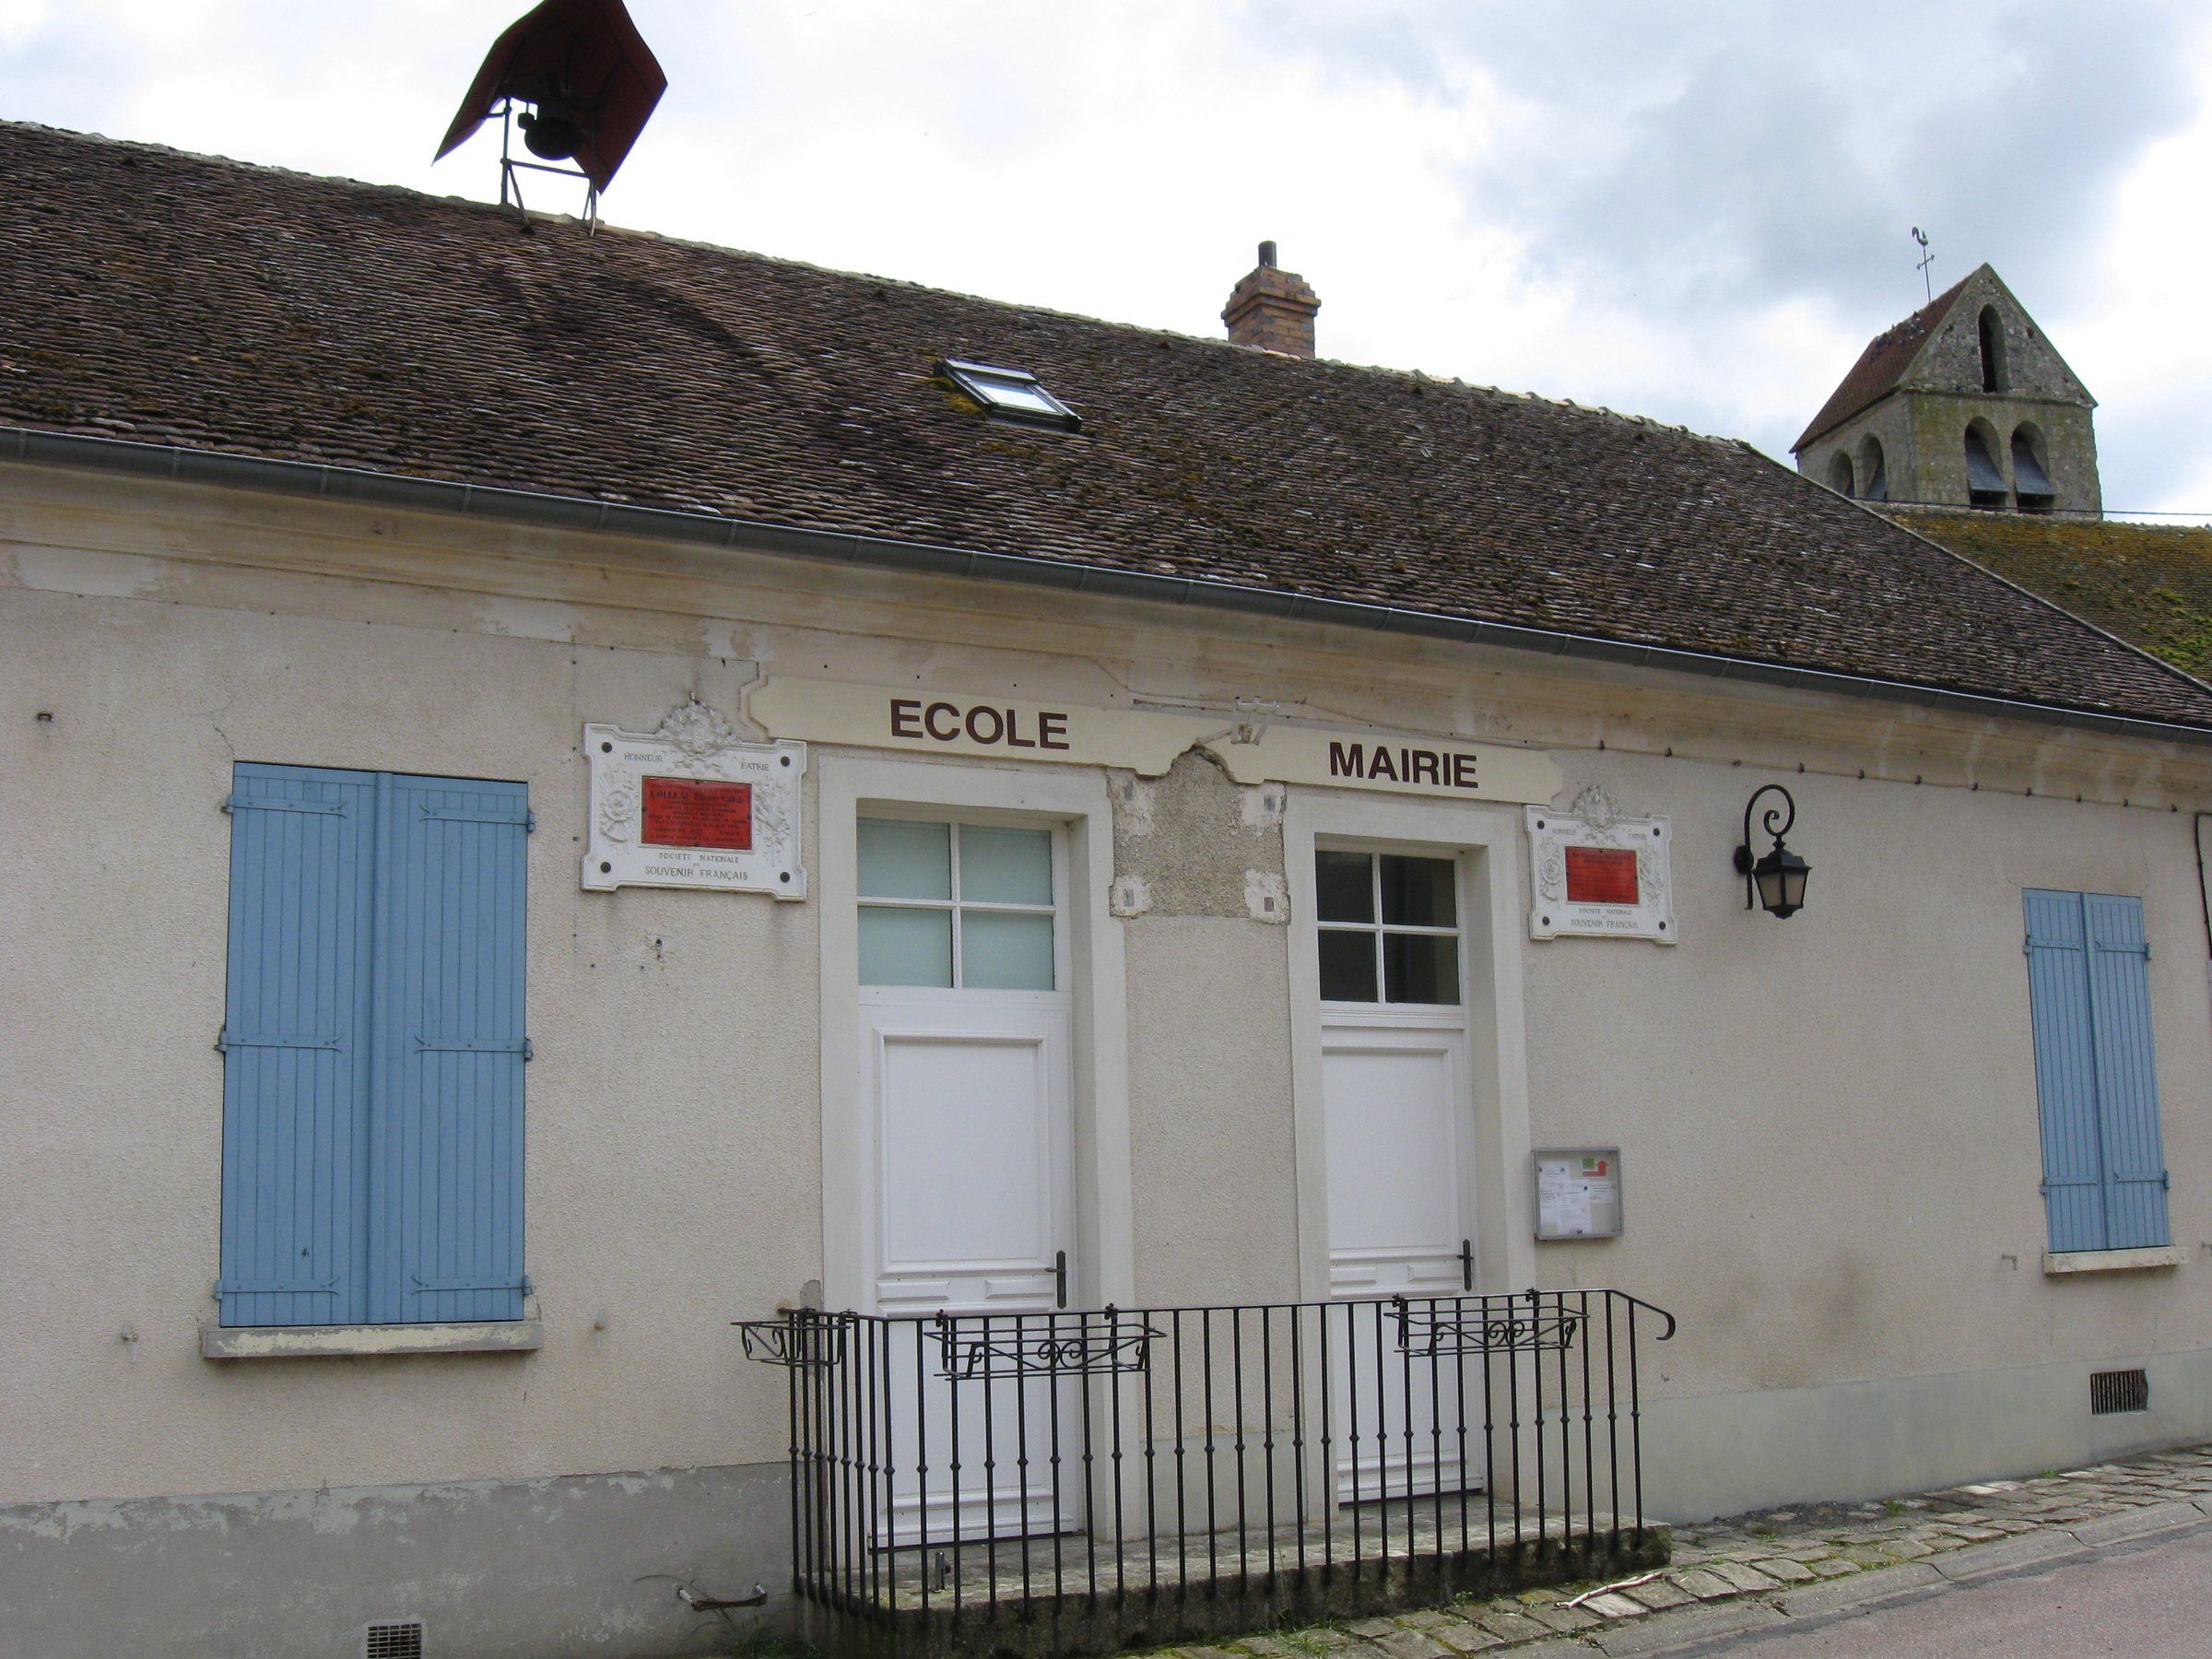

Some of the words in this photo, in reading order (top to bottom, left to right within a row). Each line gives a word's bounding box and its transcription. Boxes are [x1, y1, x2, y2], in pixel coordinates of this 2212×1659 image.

[890, 699, 1070, 750] ECOLE
[623, 752, 664, 763] HONNEUR
[740, 761, 770, 771] PATRIE
[1329, 741, 1479, 789] MAIRIE
[700, 854, 739, 864] NATIONALE
[644, 865, 694, 877] SOUVENIR
[700, 868, 748, 881] FRANÇAIS
